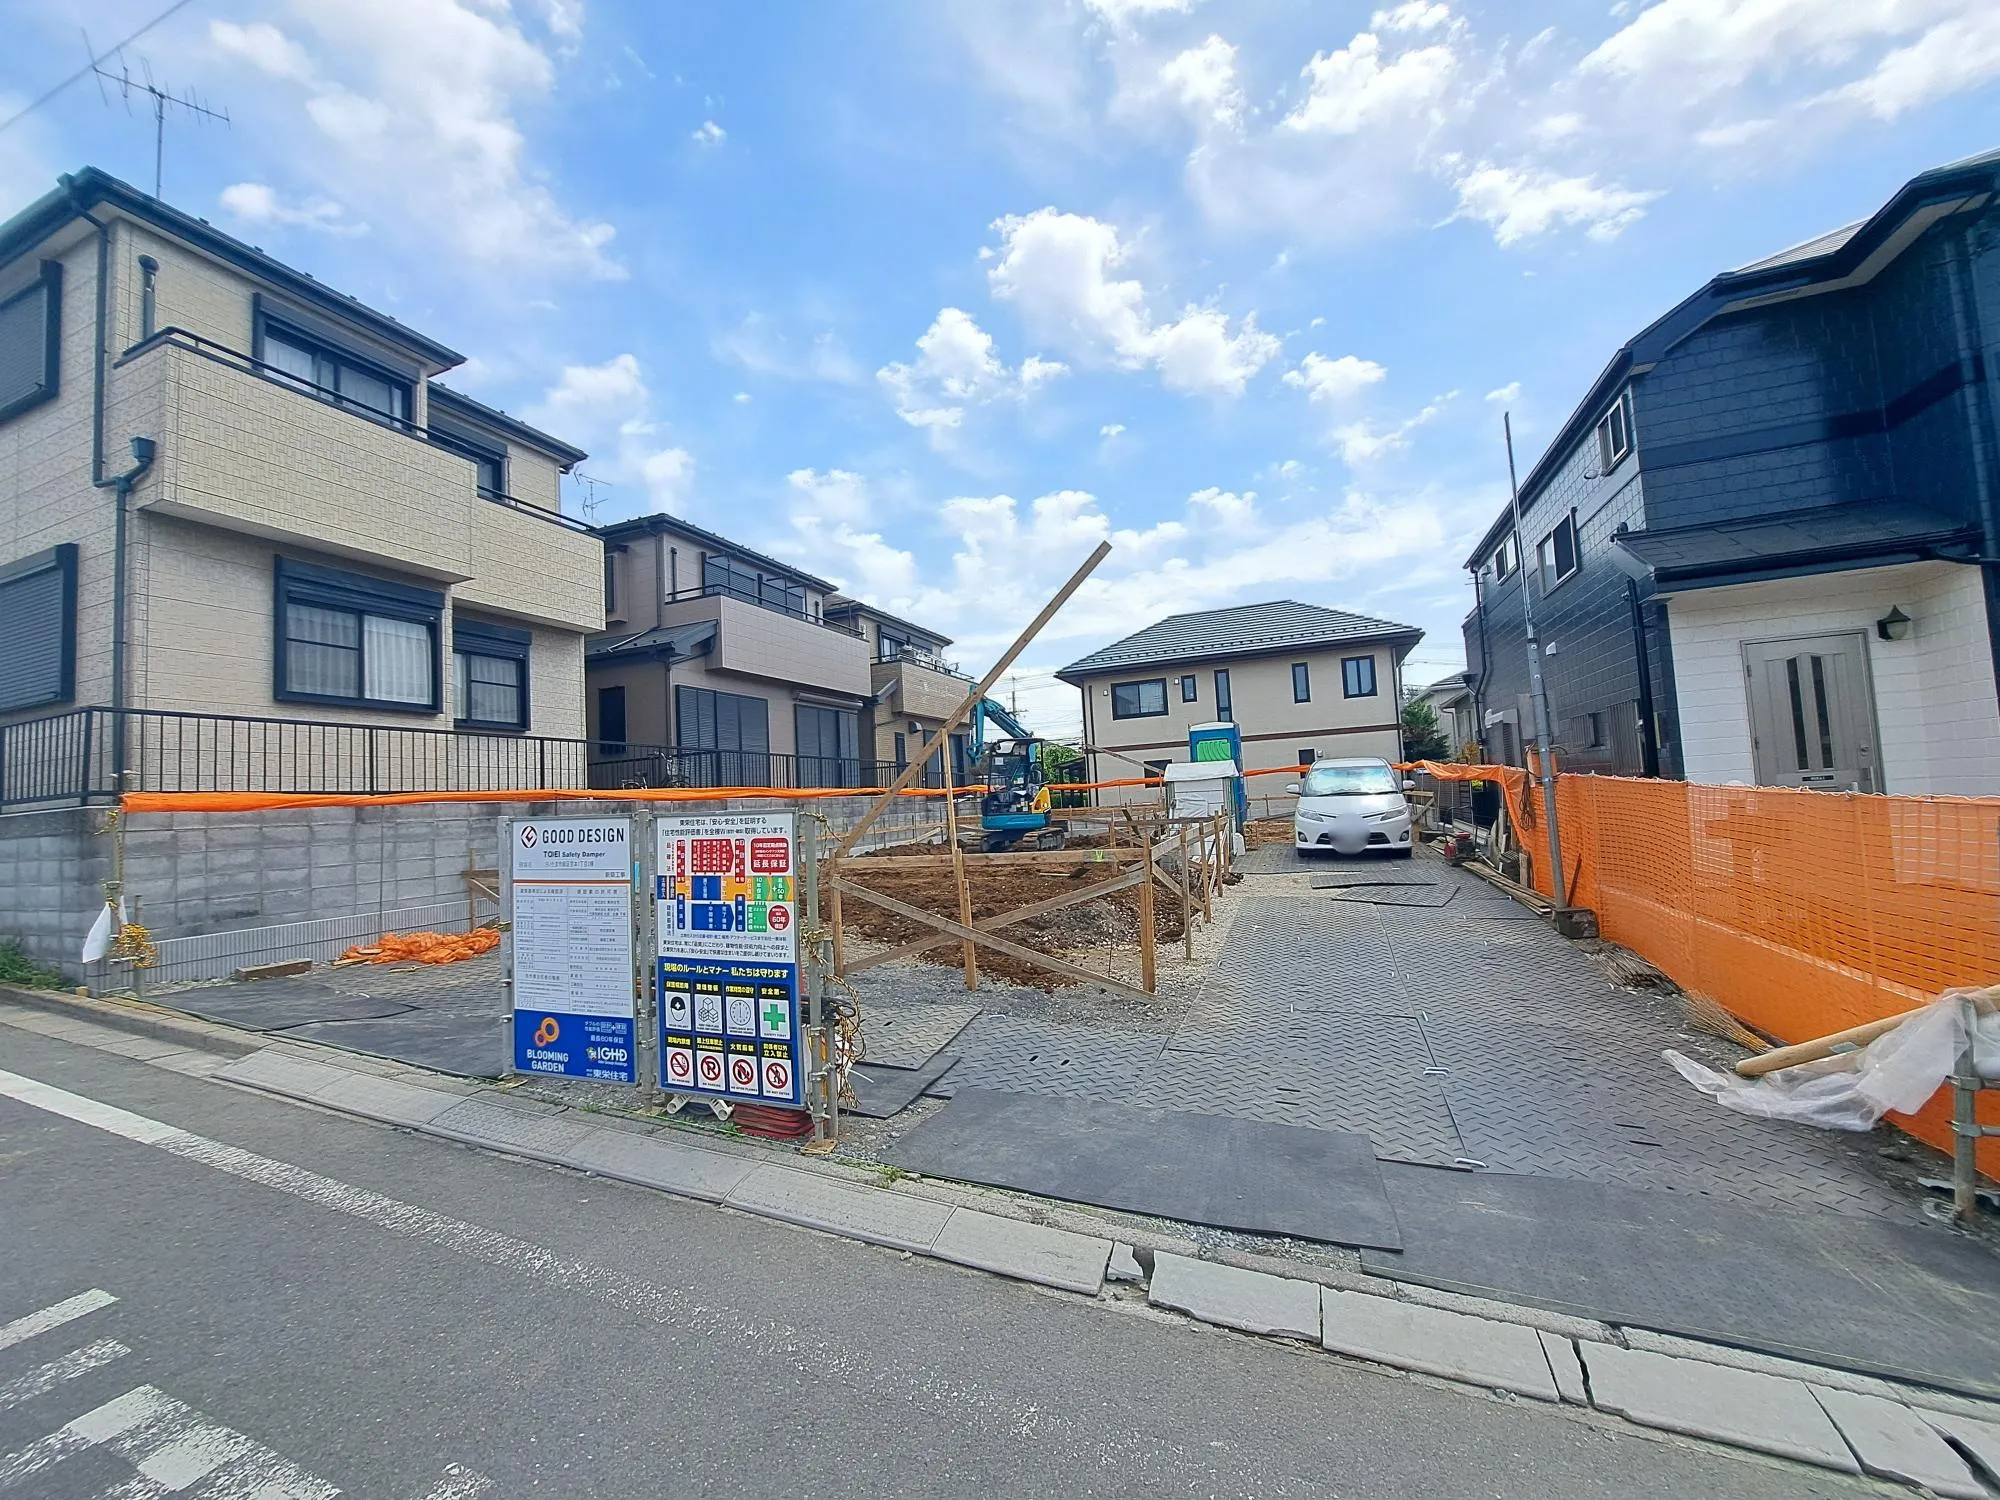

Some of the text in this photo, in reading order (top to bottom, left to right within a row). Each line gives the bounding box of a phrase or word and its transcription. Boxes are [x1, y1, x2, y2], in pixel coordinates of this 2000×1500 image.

[542, 827, 624, 844] GOOD DESIGN
[562, 851, 581, 859] Safety
[664, 962, 789, 979] 現場のルールとマナー 私たちは守ります
[761, 987, 786, 996] 安全第一
[526, 1048, 569, 1062] BLOOMING
[763, 1050, 789, 1058] 立入禁止
[531, 1060, 565, 1073] GARDEN
[593, 1069, 628, 1082] 東栄住宅
